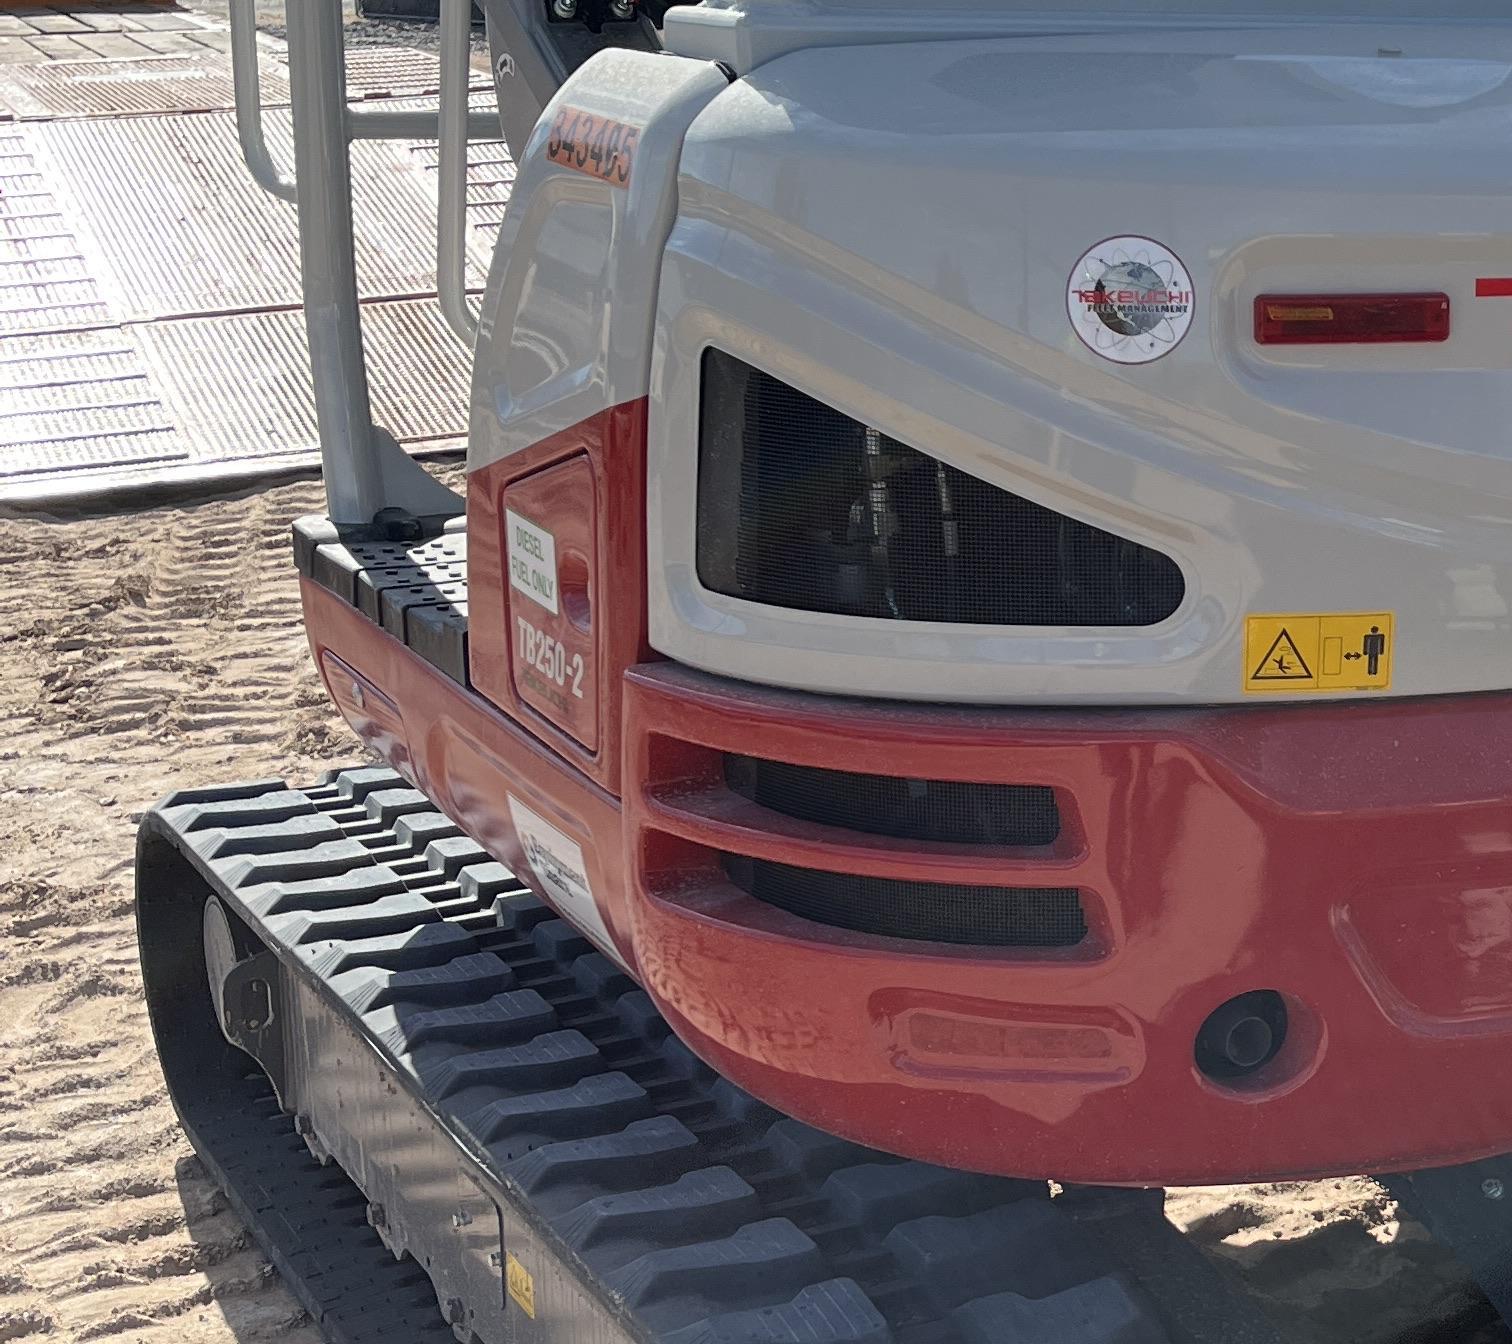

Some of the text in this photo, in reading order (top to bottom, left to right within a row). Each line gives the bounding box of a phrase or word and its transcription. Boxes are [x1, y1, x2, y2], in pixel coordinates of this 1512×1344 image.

[547, 109, 638, 182] 343405
[1117, 304, 1188, 314] MANAGEMENT
[515, 525, 545, 563] DIESEL
[511, 555, 555, 602] FUEL ONLY
[517, 614, 585, 700] TB250-2
